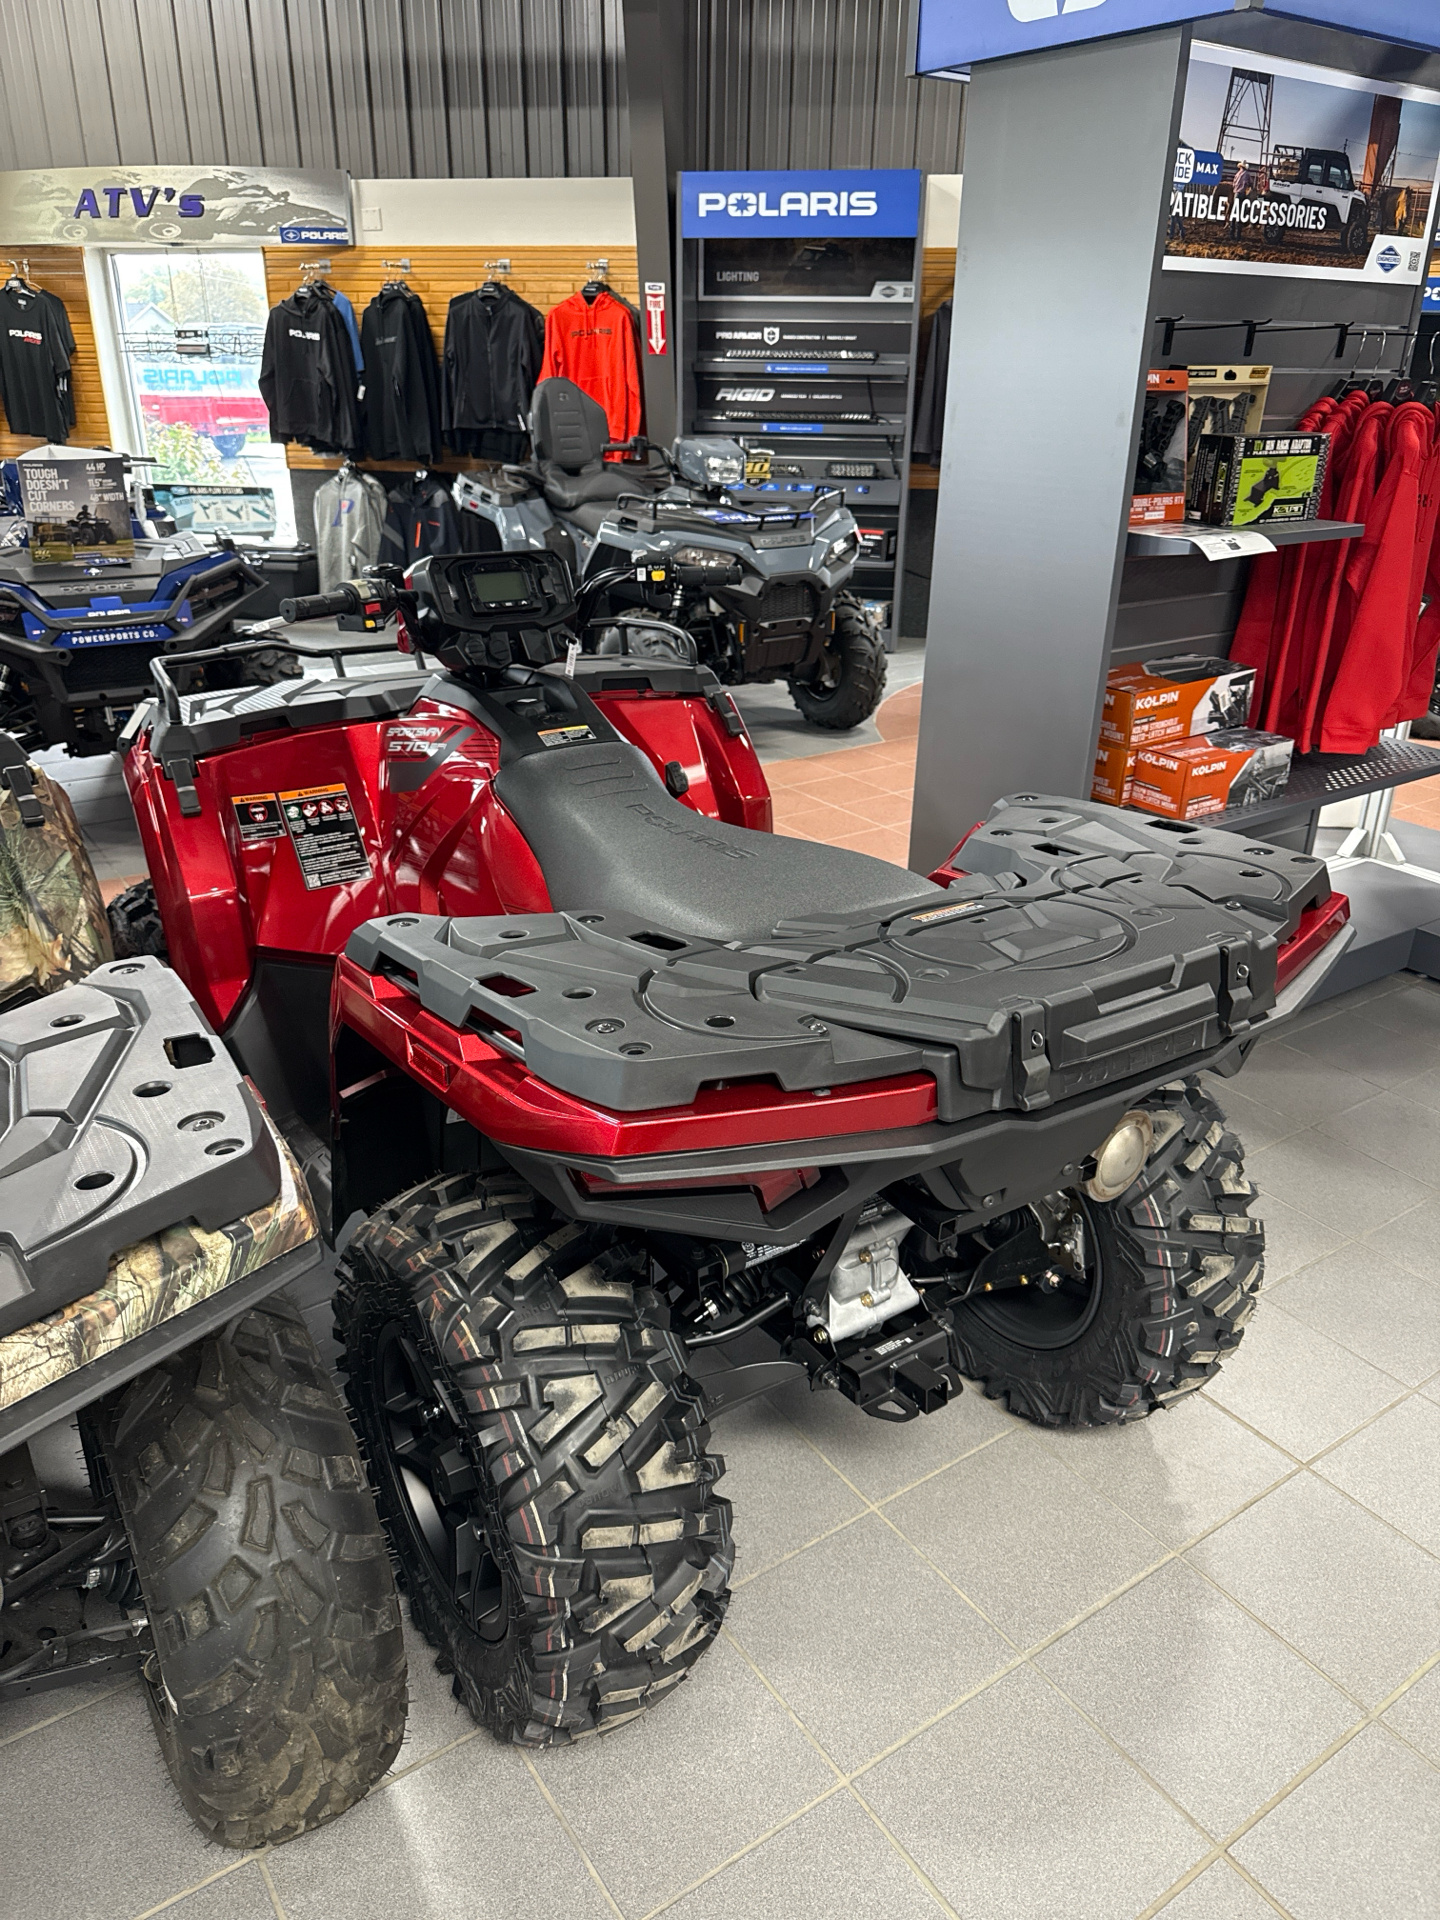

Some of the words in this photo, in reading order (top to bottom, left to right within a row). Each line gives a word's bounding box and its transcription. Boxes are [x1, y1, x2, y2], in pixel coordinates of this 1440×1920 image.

[1177, 152, 1192, 165] CK
[1174, 166, 1191, 179] IDE
[1195, 162, 1219, 175] MAX
[73, 187, 206, 219] ATV's
[697, 191, 878, 218] POLARIS
[1229, 197, 1328, 231] ACCESSORIES
[301, 231, 349, 240] POLARIS
[716, 271, 760, 282] LIGHTING
[649, 300, 662, 309] FIRE
[8, 329, 42, 341] POLARIS
[570, 328, 612, 338] POLARIS
[733, 331, 762, 340] ARMOR
[715, 388, 776, 402] RIGID
[86, 463, 95, 471] 44
[96, 462, 107, 471] HP
[24, 468, 58, 480] TOUGH
[26, 479, 70, 491] DOESN'T
[28, 491, 48, 502] CUT
[103, 492, 124, 502] WIDTH
[29, 500, 75, 512] CORNERS
[60, 581, 136, 594] POLARIS
[71, 630, 141, 645] POWERSPORTS
[142, 629, 159, 639] CO.
[1135, 690, 1180, 711] KOLPIN
[386, 727, 445, 739] SPORTSMAN
[388, 741, 430, 752] 570
[1138, 751, 1180, 771] KOLPIN
[1191, 761, 1228, 777] KOLPIN
[303, 787, 329, 796] WARNING
[1060, 1027, 1198, 1096] POLARIS
